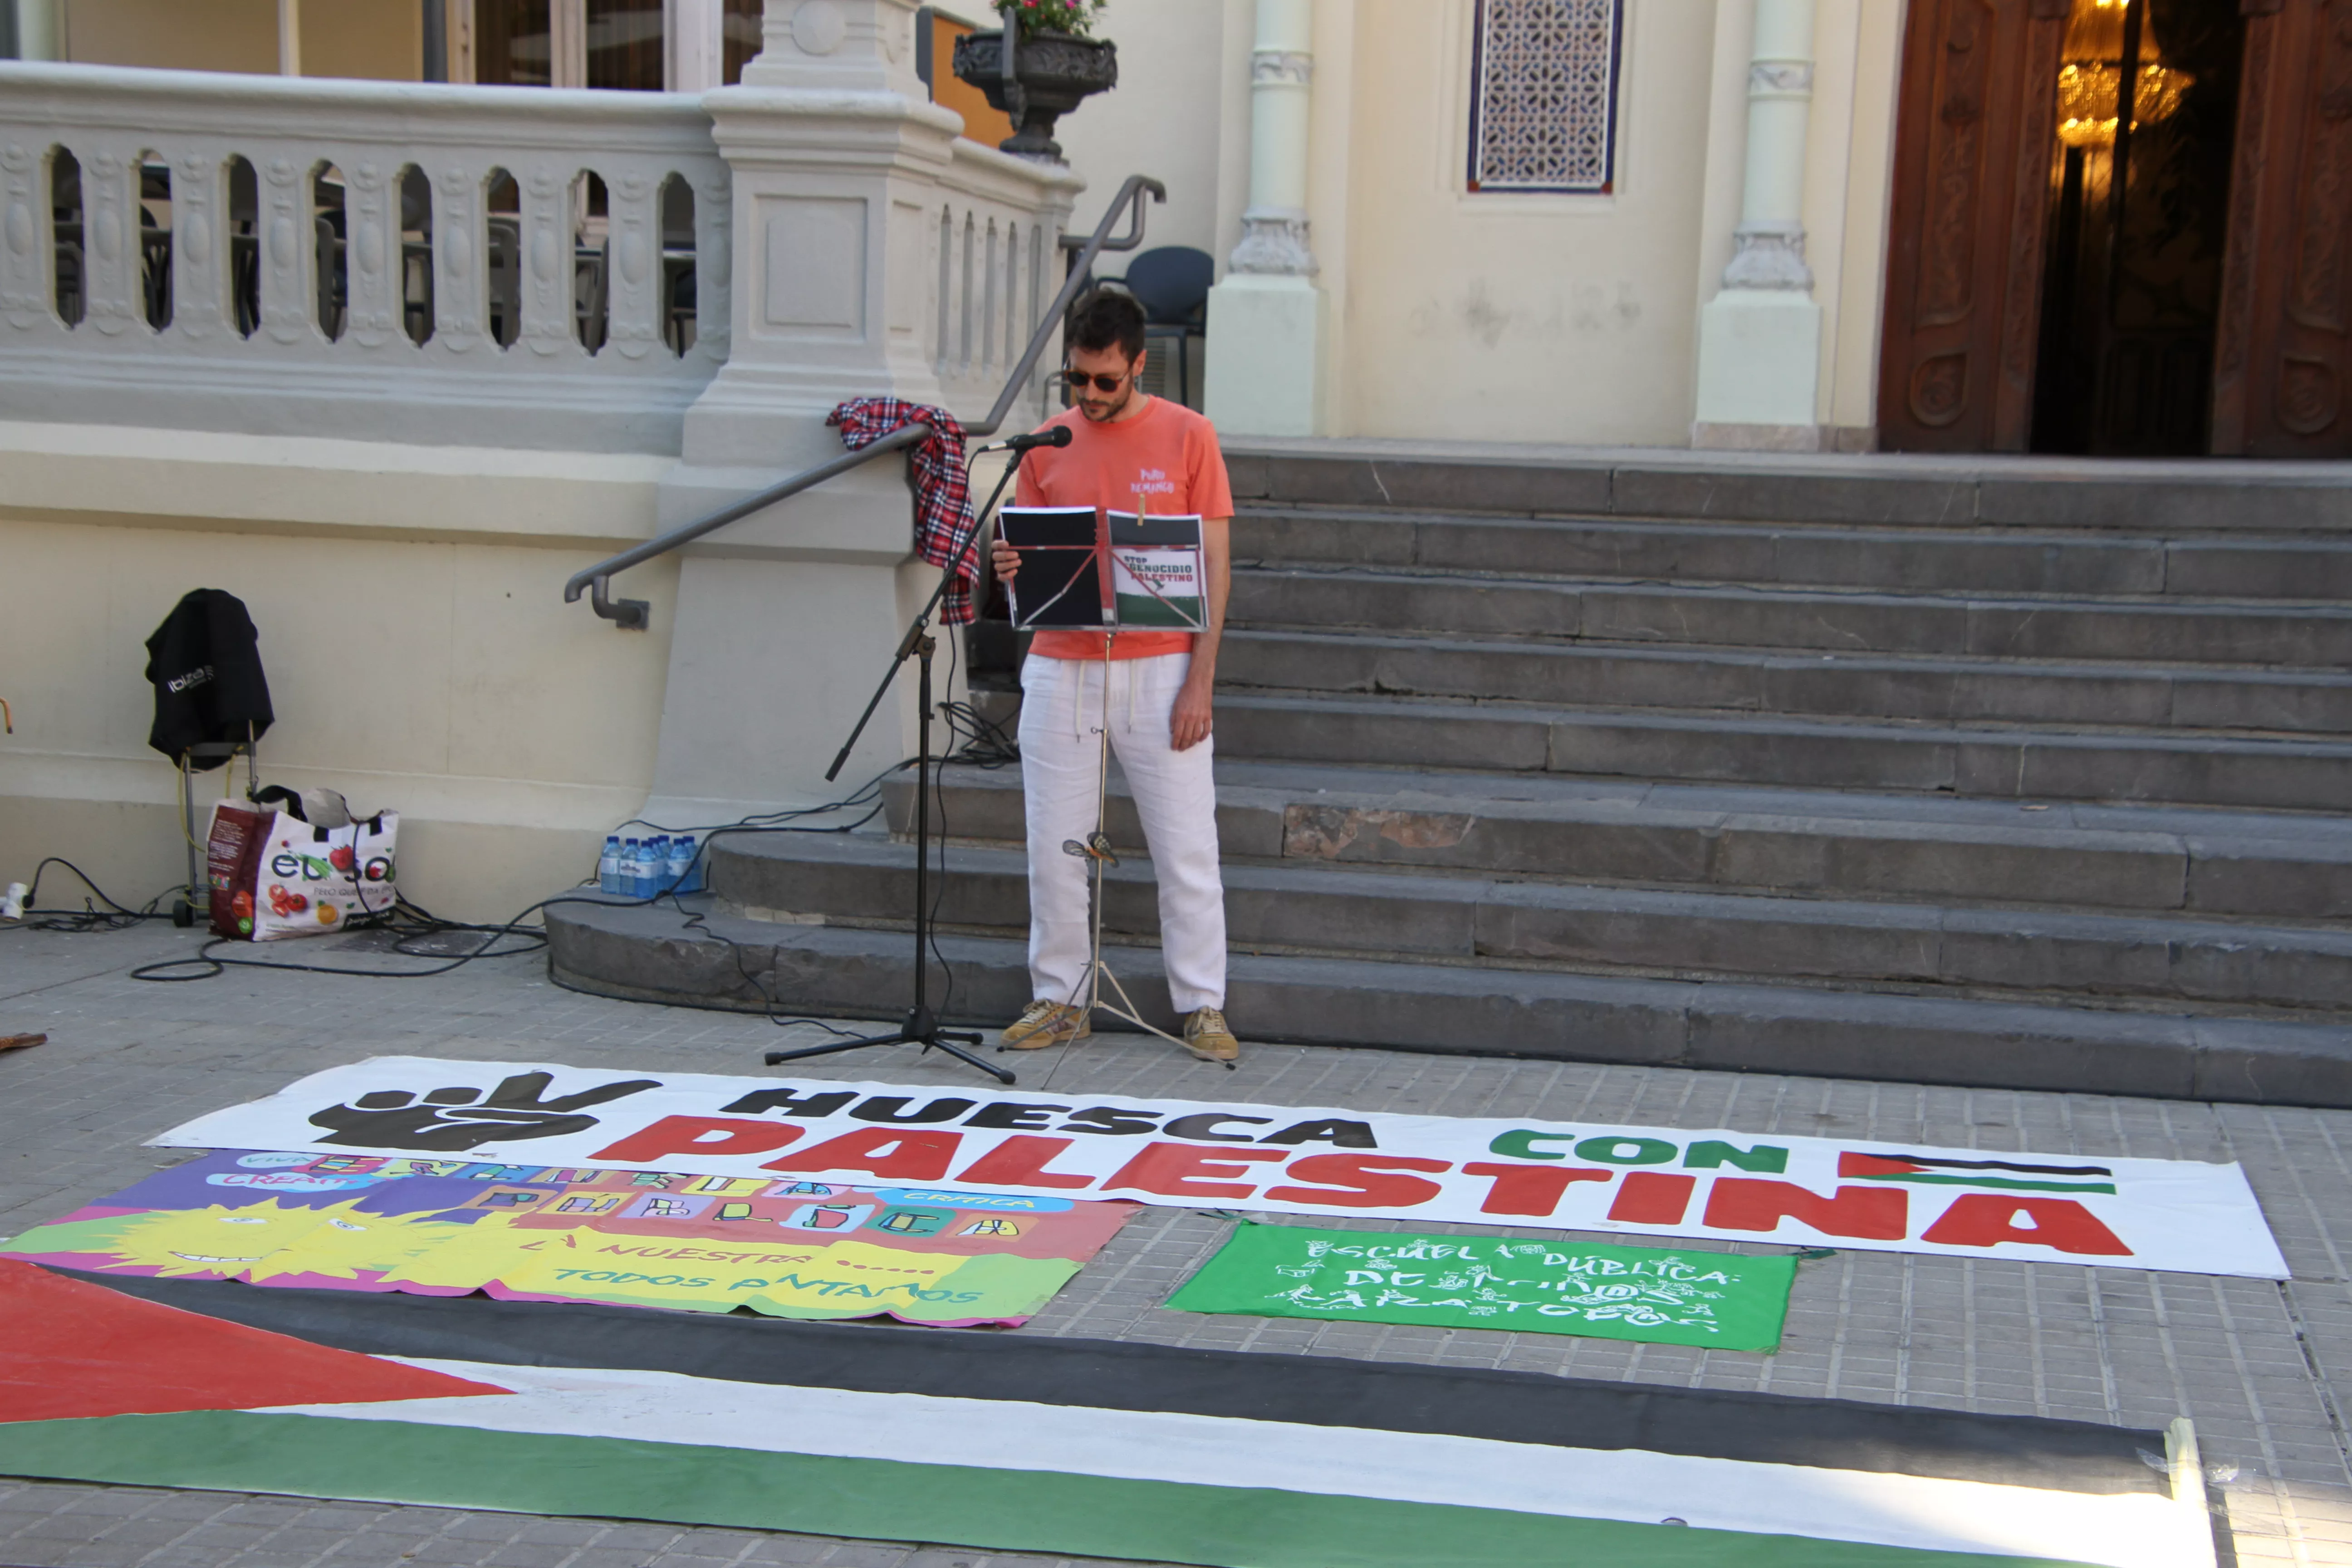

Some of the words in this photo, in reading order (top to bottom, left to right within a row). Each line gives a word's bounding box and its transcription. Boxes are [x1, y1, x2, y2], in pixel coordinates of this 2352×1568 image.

[1129, 564, 1192, 573] GENOCIDIO
[719, 1089, 1378, 1149] HUESCA
[1490, 1129, 1788, 1173] CON
[588, 1114, 2134, 1256] PALESTINA
[903, 1193, 1035, 1208] CRÍTICA
[597, 1245, 814, 1264] NUESTRA
[553, 1269, 715, 1287] TODOS
[1343, 1270, 1427, 1286] DE
